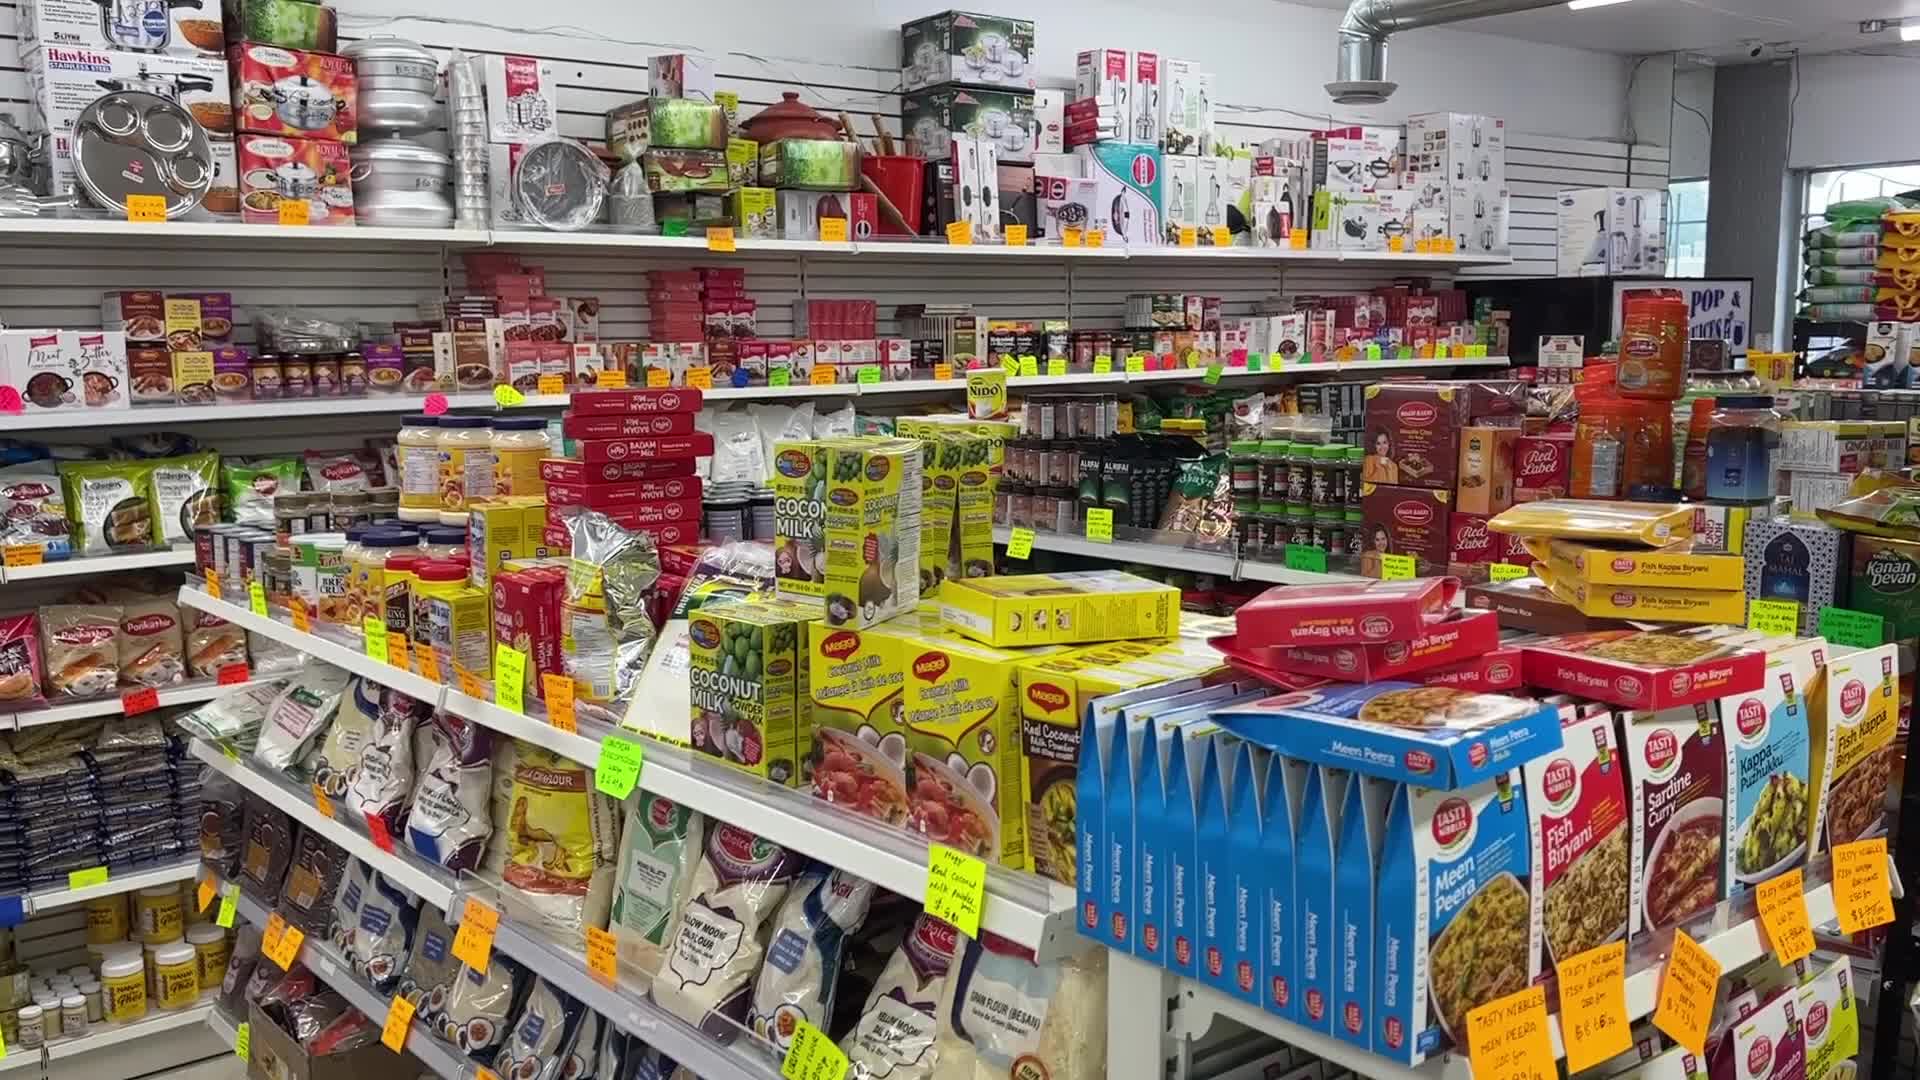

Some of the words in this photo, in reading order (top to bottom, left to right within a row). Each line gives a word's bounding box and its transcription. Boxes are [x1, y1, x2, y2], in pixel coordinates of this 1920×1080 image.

[48, 49, 110, 64] Hawkins
[1690, 289, 1724, 318] POP
[1731, 290, 1741, 309] &
[970, 385, 998, 396] NIDO
[630, 441, 656, 449] BADAM
[985, 438, 1003, 448] DO
[1526, 448, 1556, 466] Red
[1523, 460, 1556, 476] Label
[776, 517, 813, 538] MILK
[1458, 526, 1487, 540] Red
[1456, 536, 1488, 550] Label
[1867, 561, 1911, 574] Kanan
[1872, 572, 1916, 586] Devan
[1334, 623, 1355, 636] Fish
[1412, 635, 1429, 649] Fish
[690, 666, 761, 700] COCONUT
[1558, 667, 1574, 680] Fish
[1577, 671, 1609, 688] Biryani
[1693, 670, 1709, 682] Fish
[690, 688, 724, 714] MILK
[1030, 687, 1067, 704] Maggi
[1739, 708, 1761, 720] TASTY
[1024, 720, 1041, 736] Real
[1042, 726, 1080, 744] Coconut
[1838, 729, 1858, 753] Fish
[1859, 709, 1888, 739] Kappa
[1030, 735, 1046, 747] Milk
[1648, 735, 1672, 750] TASTY
[1740, 744, 1772, 775] Kappa
[1545, 765, 1571, 785] TASTY
[1741, 754, 1784, 792] Puzhukku
[1648, 772, 1692, 811] Sardine
[1437, 806, 1466, 825] TASTY
[1649, 801, 1677, 828] Curry
[721, 829, 750, 849] Choice
[1547, 820, 1573, 848] Fish
[1548, 822, 1594, 871] Biryani
[1435, 856, 1475, 894] Meen
[1435, 878, 1477, 920] Peera
[922, 920, 954, 945] hoice
[986, 997, 1009, 1017] FLOUR
[1008, 1005, 1041, 1031] (BESAN)
[1506, 1022, 1537, 1040] PEERA
[1750, 1044, 1769, 1059] TASTY
